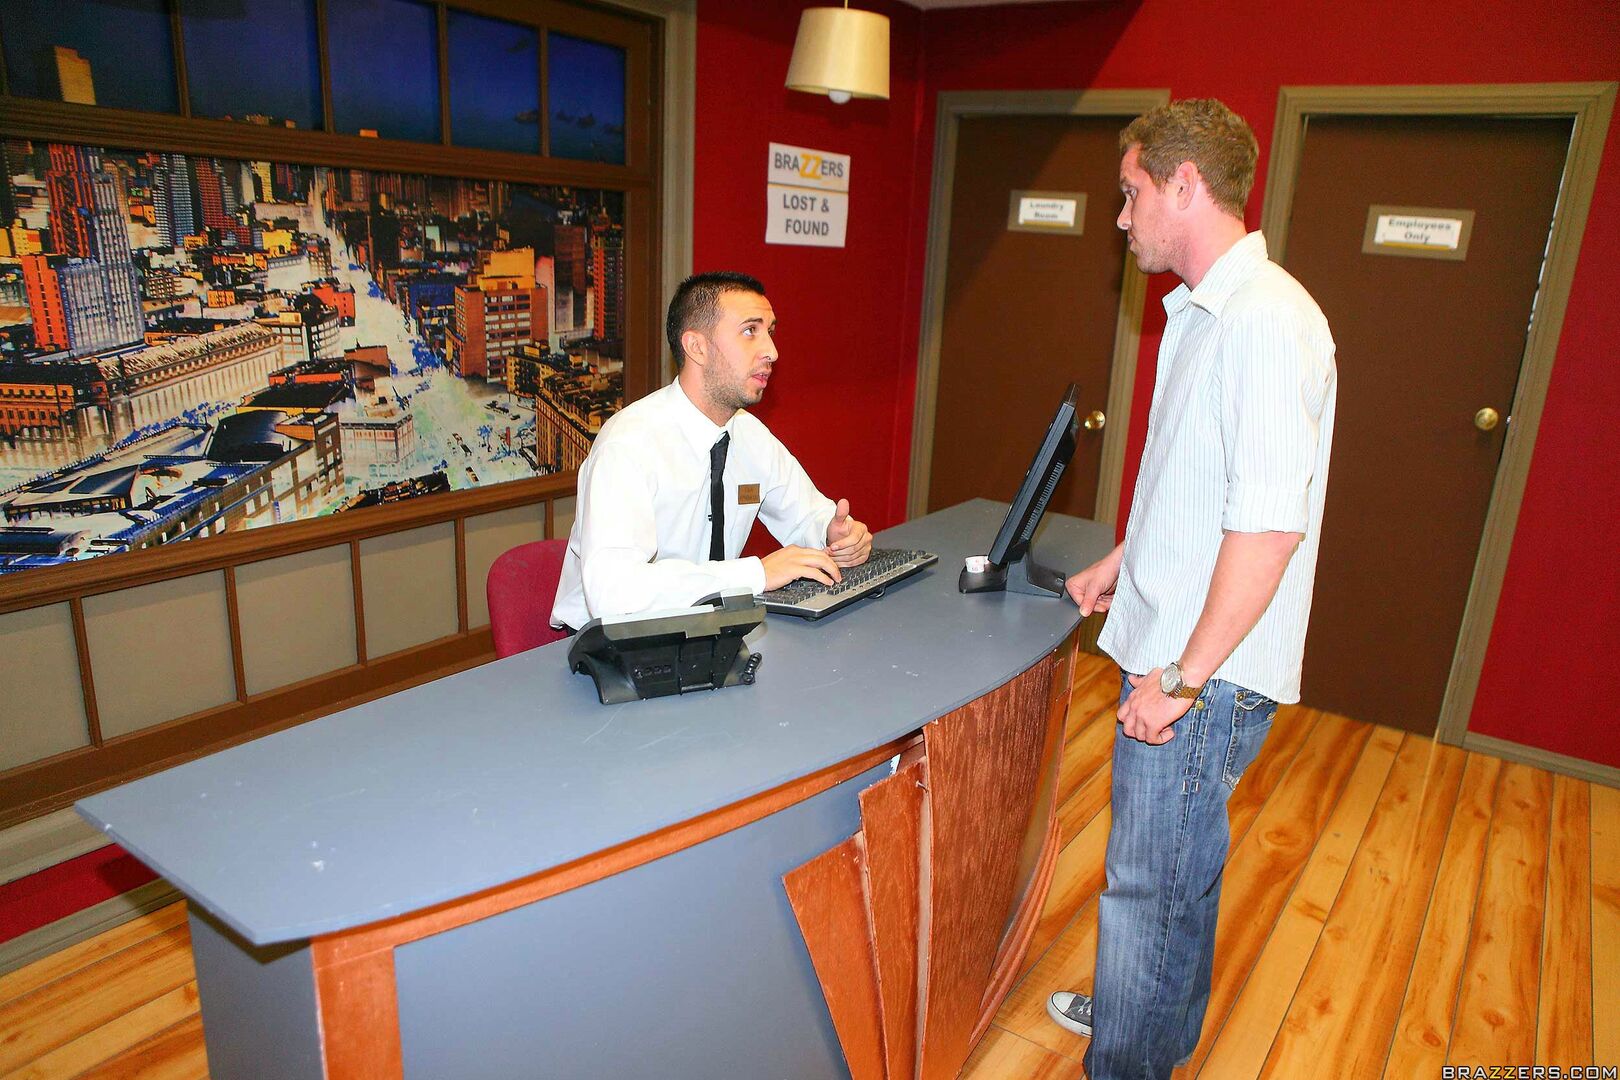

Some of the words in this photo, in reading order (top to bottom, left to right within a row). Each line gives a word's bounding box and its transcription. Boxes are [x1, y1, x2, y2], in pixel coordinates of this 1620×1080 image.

[774, 152, 845, 180] BRAZZERS
[783, 194, 816, 212] LOST
[821, 198, 830, 213] &
[785, 218, 829, 236] FOUND
[1388, 218, 1452, 231] Employees
[1404, 231, 1431, 245] Only
